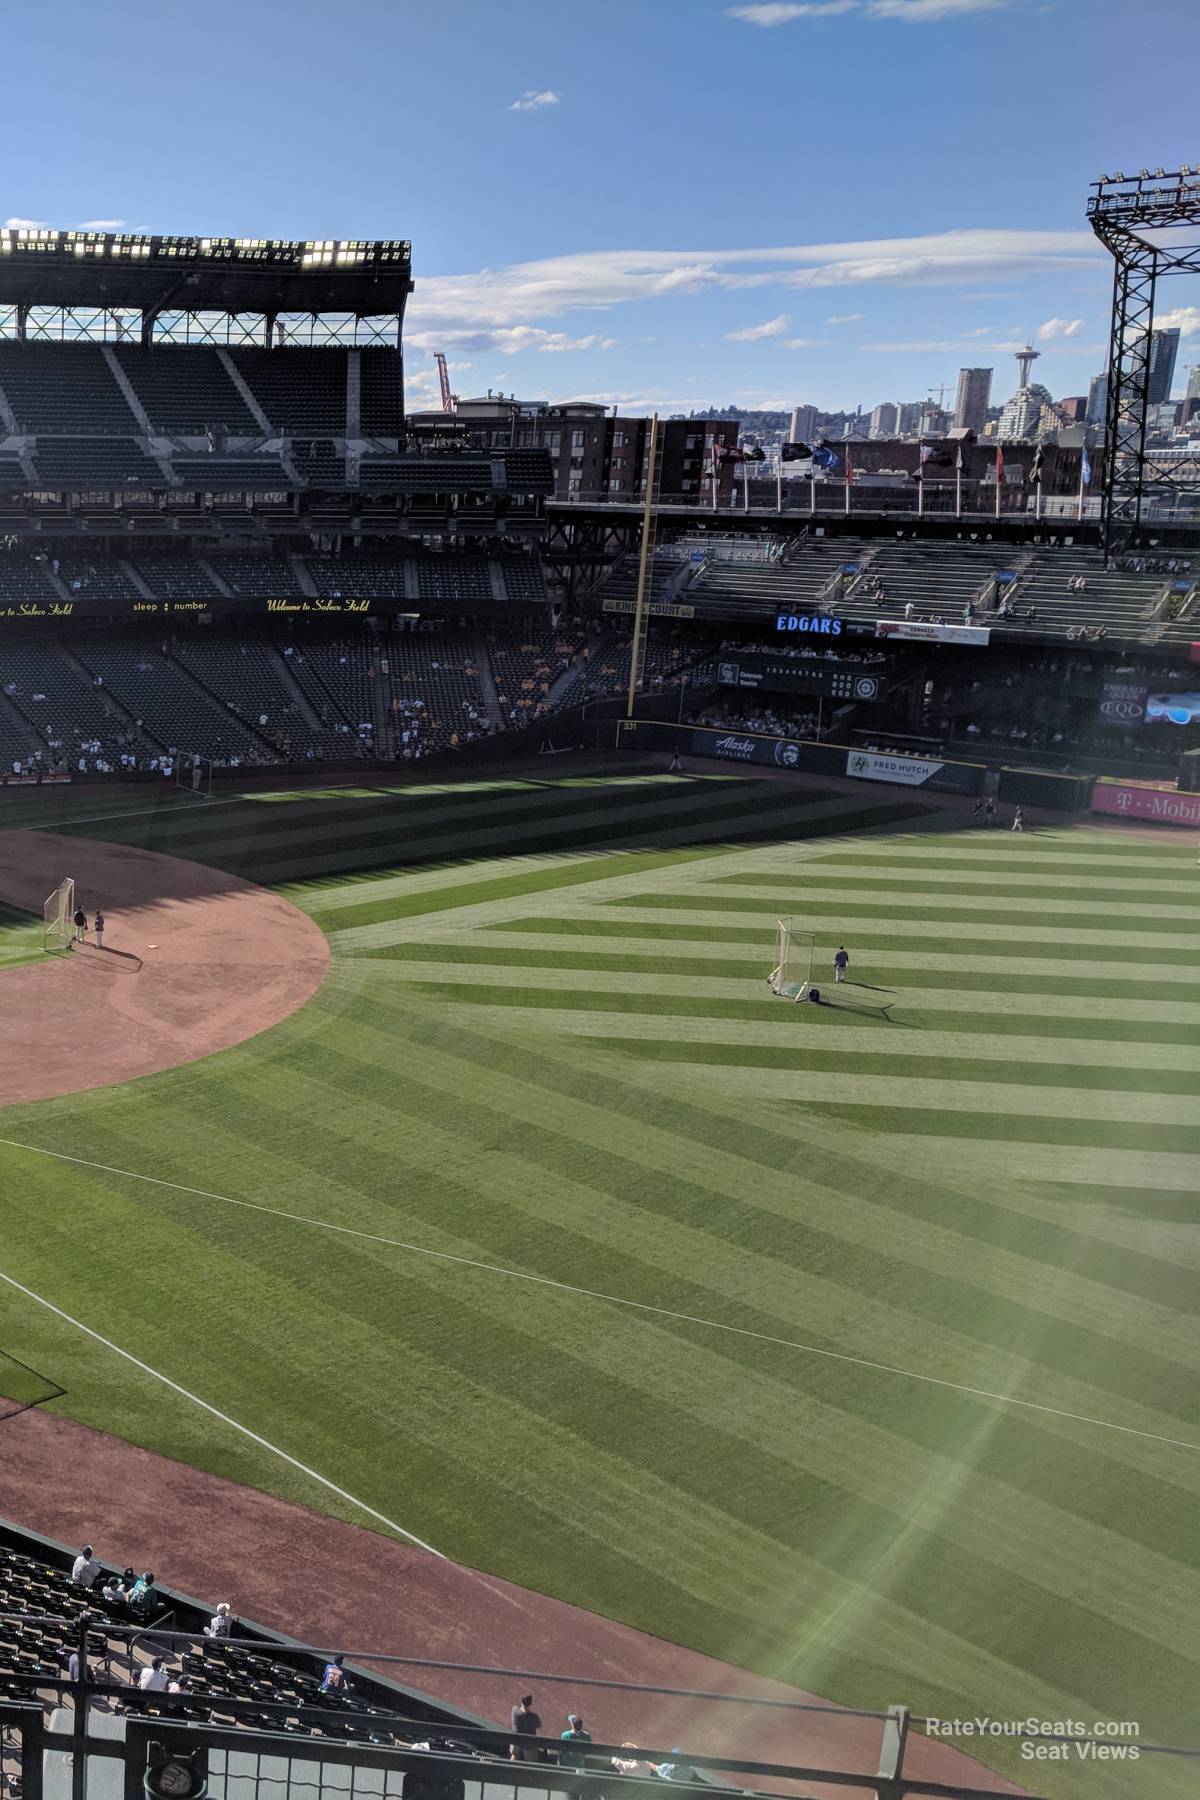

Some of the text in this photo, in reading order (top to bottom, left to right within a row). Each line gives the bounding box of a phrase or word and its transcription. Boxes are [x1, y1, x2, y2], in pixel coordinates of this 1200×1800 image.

[7, 607, 15, 616] to
[16, 604, 46, 616] Safeco
[47, 603, 74, 616] Field
[133, 601, 208, 612] sleep number
[267, 600, 371, 612] Welcome to Safeco Field
[649, 604, 681, 616] COURT
[776, 616, 842, 636] EDGARS
[623, 722, 637, 731] 331
[715, 736, 756, 752] Alaska
[874, 761, 897, 770] FRED
[899, 765, 929, 775] HUTCH
